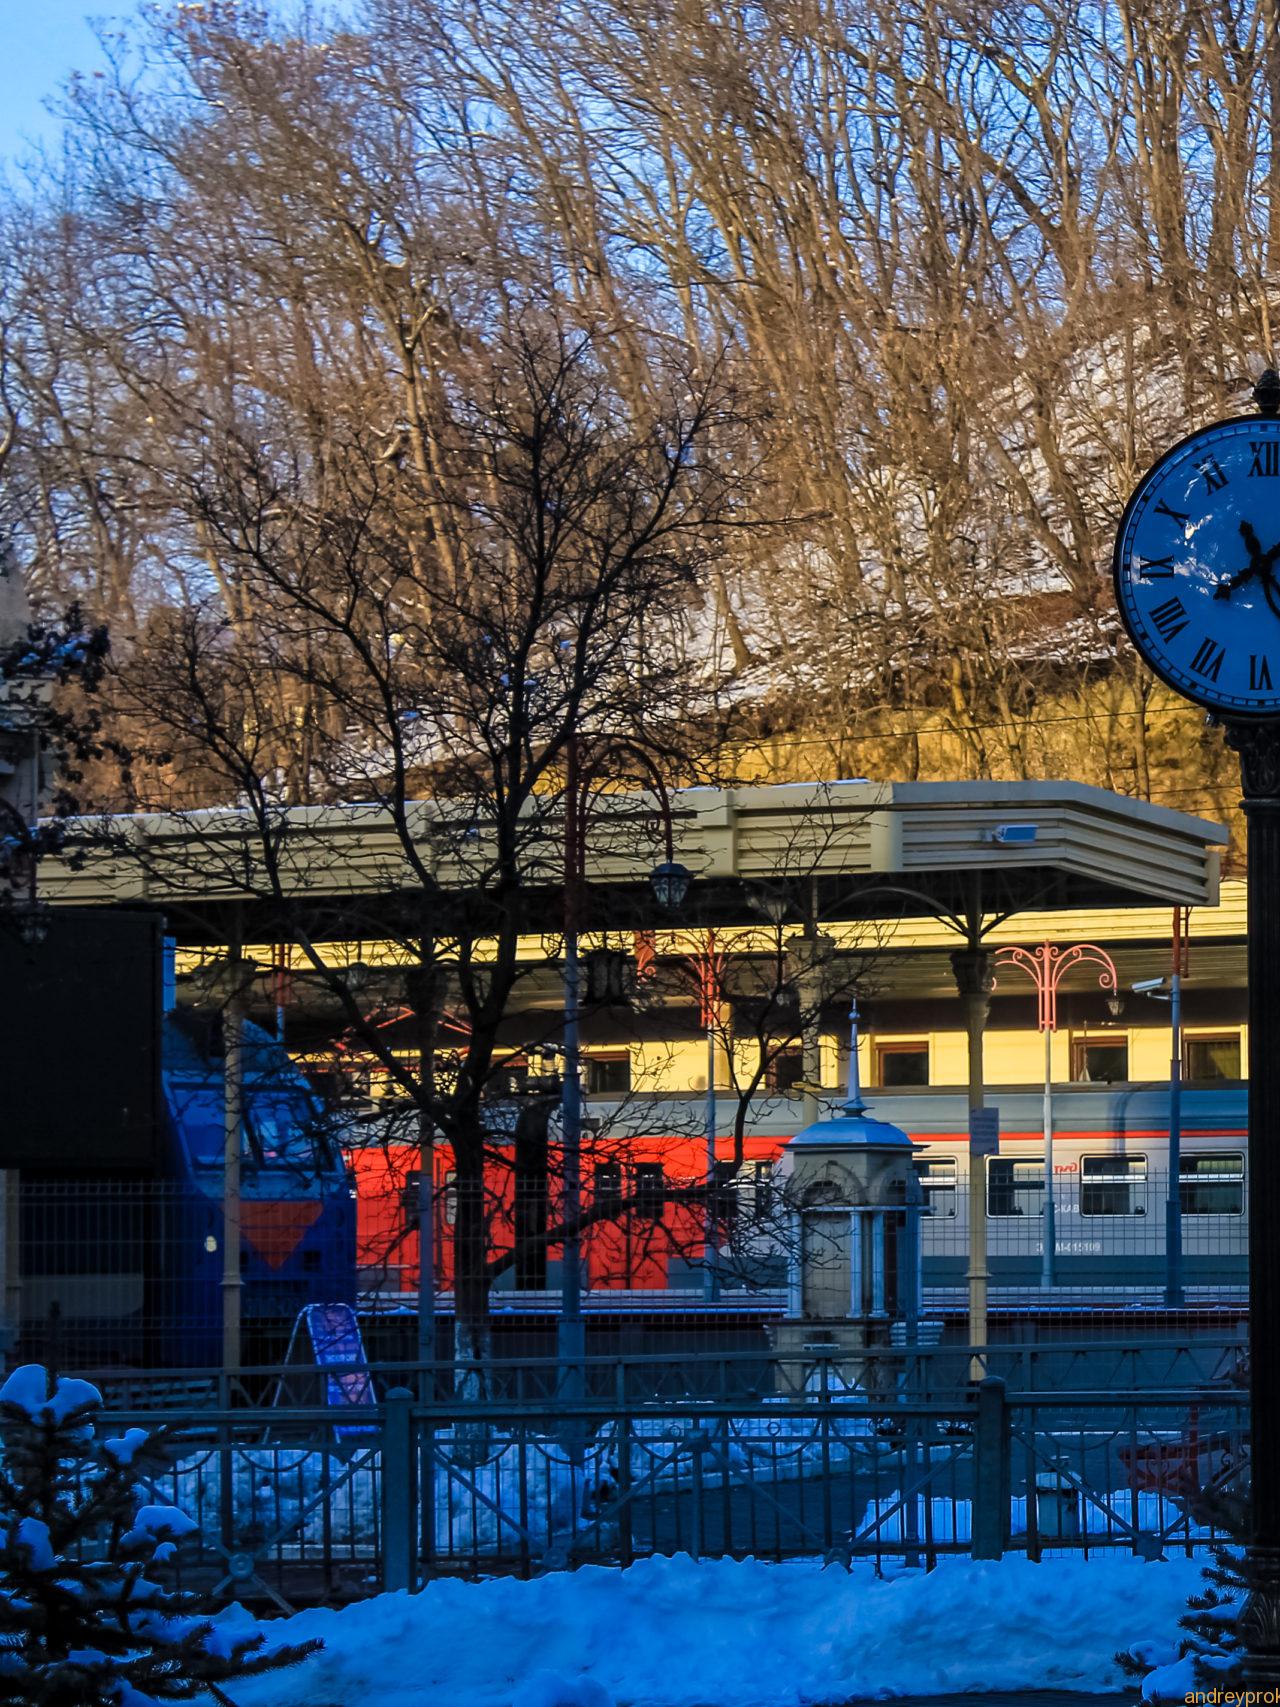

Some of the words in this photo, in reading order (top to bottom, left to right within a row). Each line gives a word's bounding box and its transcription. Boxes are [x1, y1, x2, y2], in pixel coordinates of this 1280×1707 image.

[1192, 453, 1229, 496] XI
[1248, 441, 1279, 477] XII
[1153, 499, 1190, 529] X
[1139, 554, 1175, 579] IX
[1149, 596, 1191, 644] VIII
[1189, 637, 1226, 683] VII
[1249, 655, 1273, 690] VI
